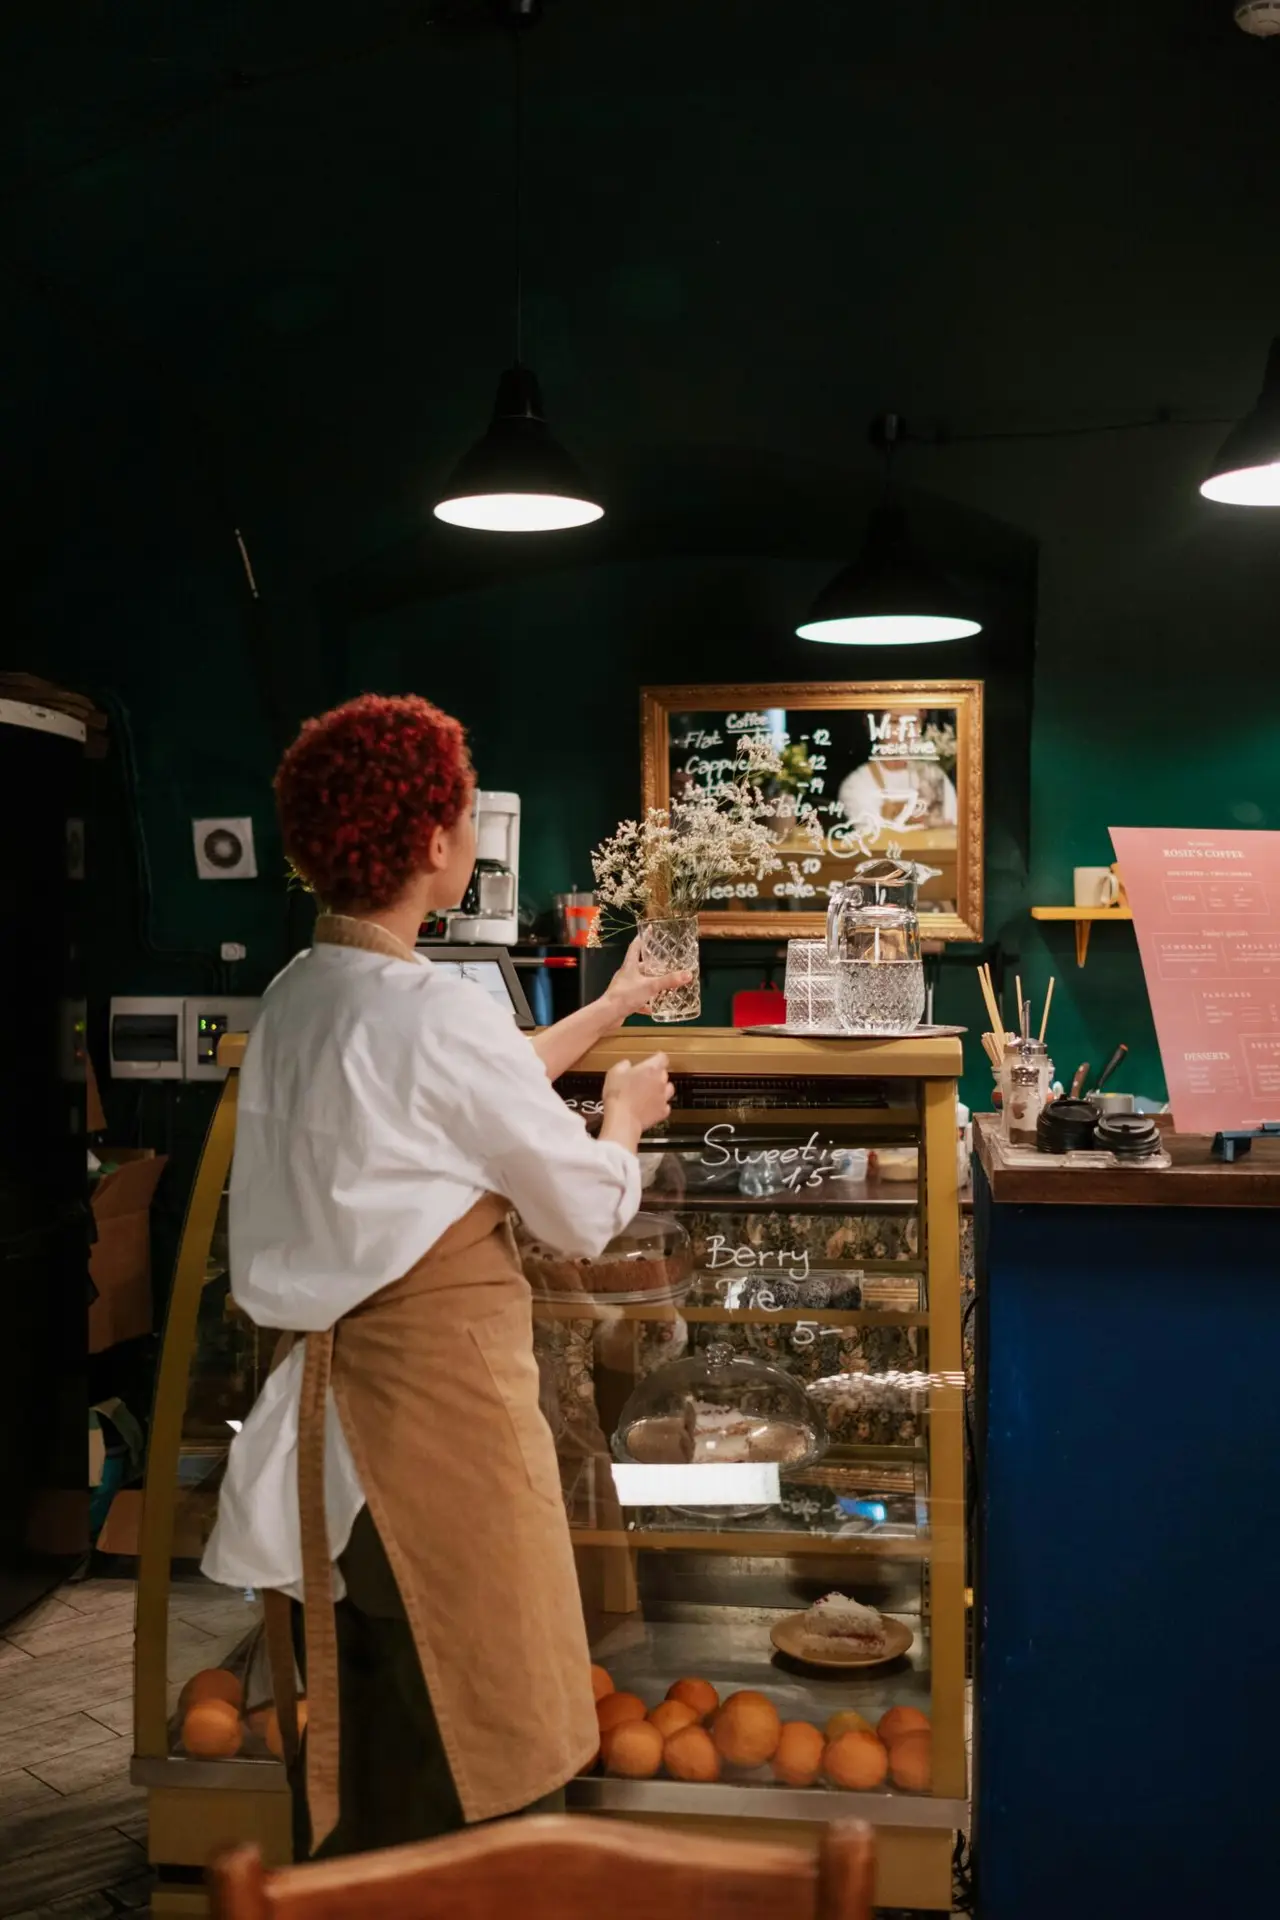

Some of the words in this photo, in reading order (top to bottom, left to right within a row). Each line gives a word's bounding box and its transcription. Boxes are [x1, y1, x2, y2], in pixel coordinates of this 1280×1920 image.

[725, 712, 769, 729] Coffee
[684, 729, 724, 748] Flat
[1163, 849, 1203, 859] ROSIE'S
[1184, 1052, 1231, 1061] DESSERTS
[700, 1122, 868, 1167] Sweeties
[705, 1235, 810, 1281] Berry
[714, 1277, 784, 1316] Pie
